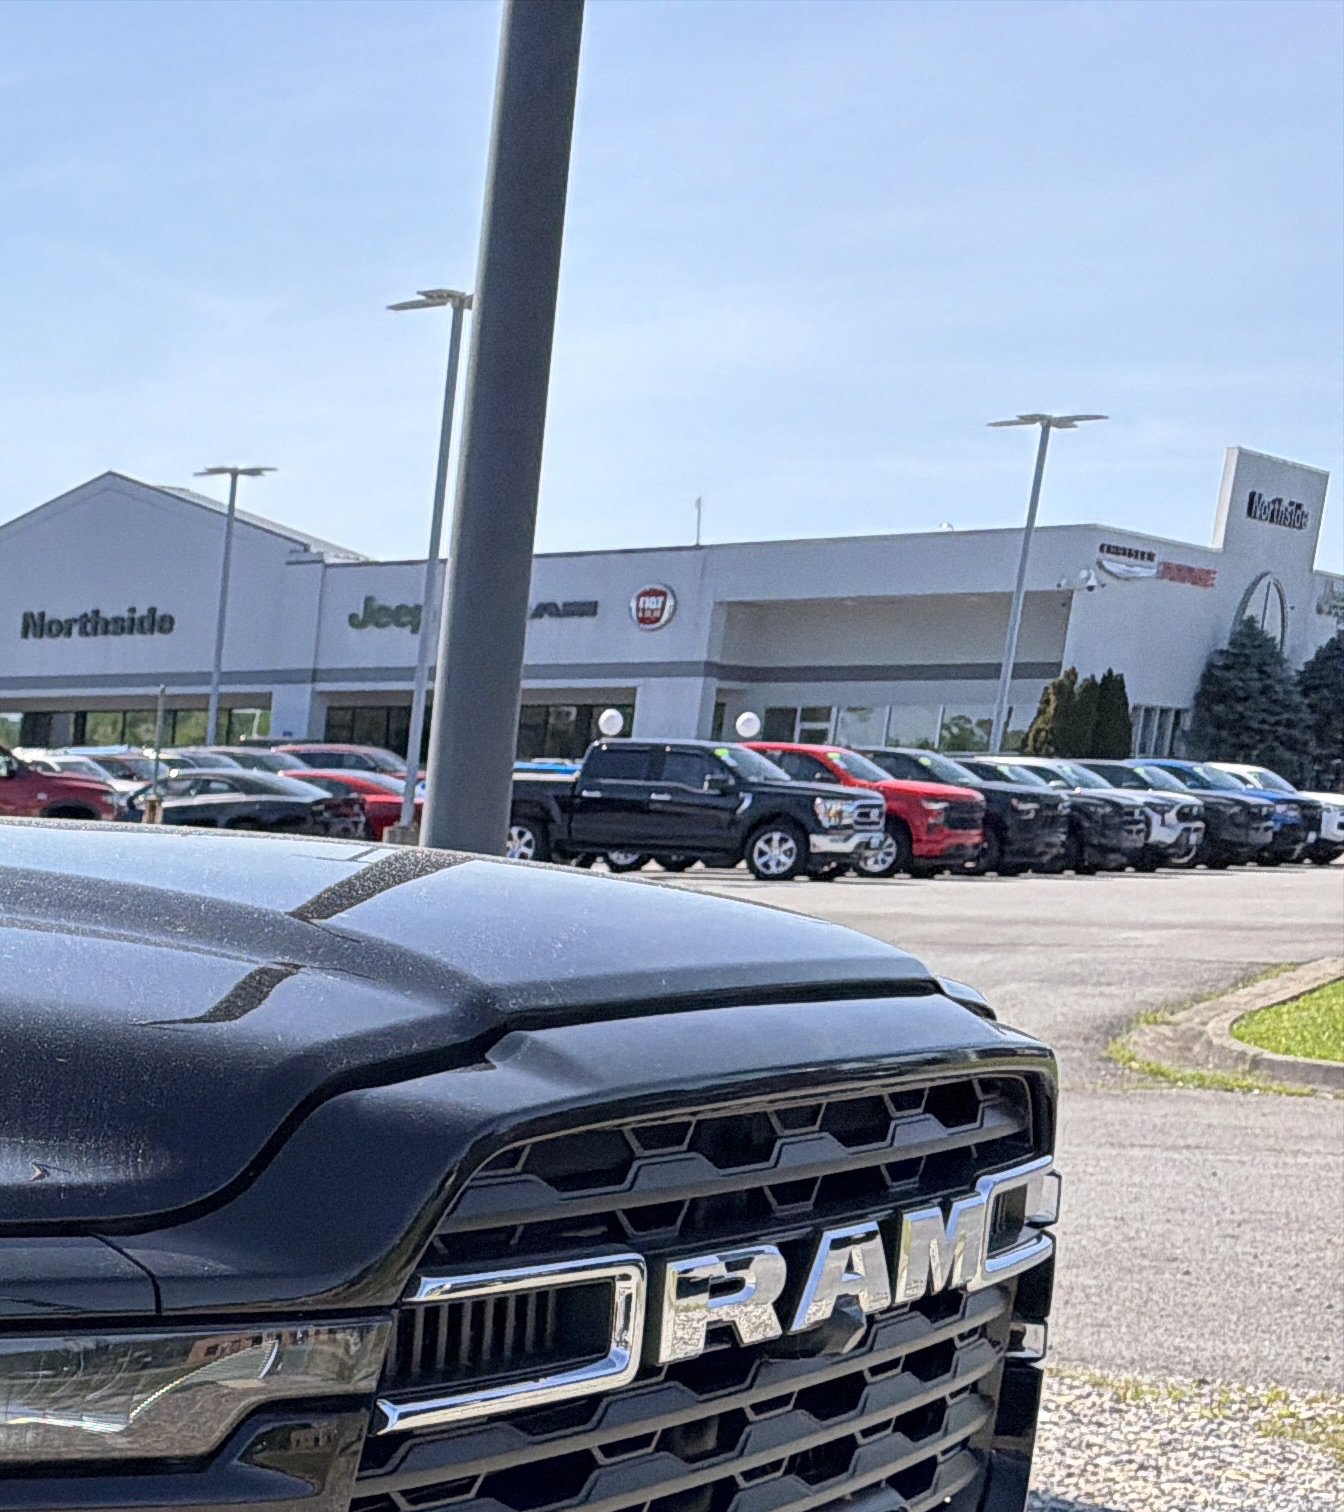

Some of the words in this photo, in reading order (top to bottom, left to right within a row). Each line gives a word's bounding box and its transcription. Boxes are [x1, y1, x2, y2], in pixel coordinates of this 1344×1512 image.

[21, 607, 175, 639] Northside
[348, 595, 422, 634] Jeep
[530, 600, 598, 619] AM
[658, 1195, 991, 1364] RAM
